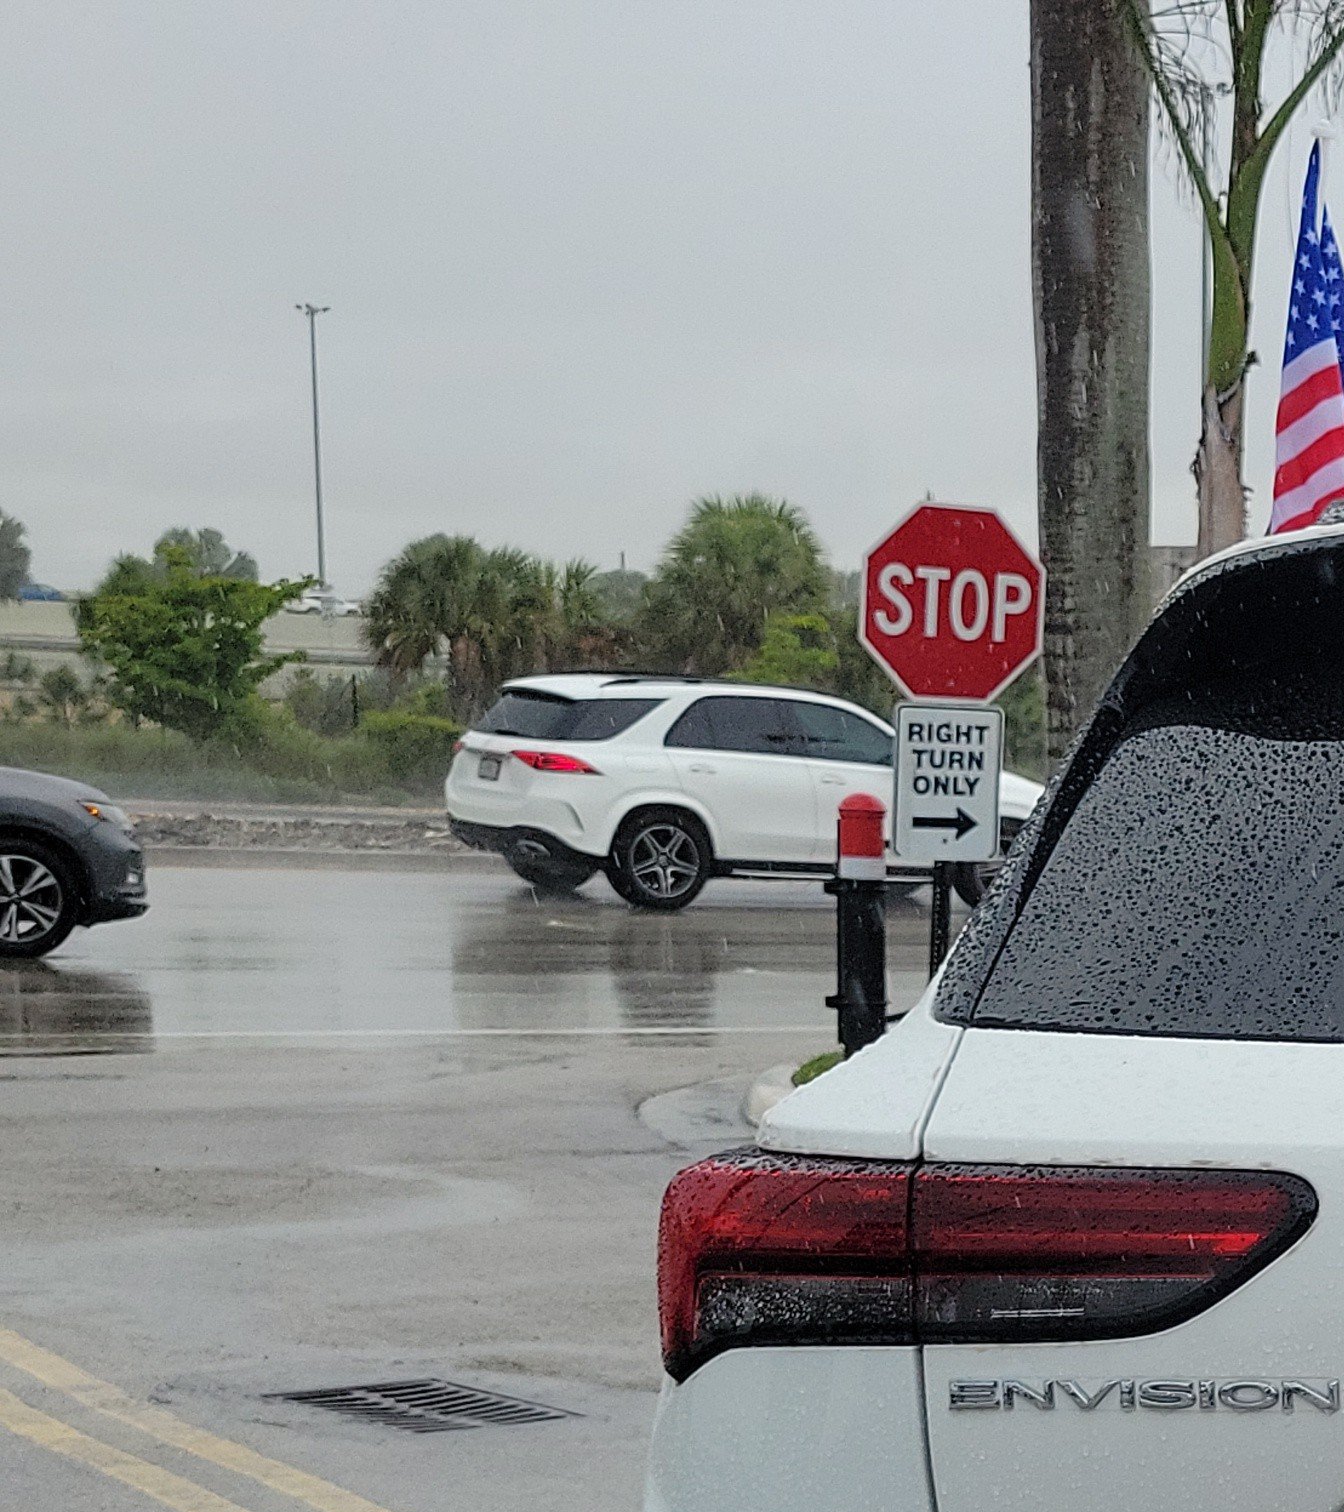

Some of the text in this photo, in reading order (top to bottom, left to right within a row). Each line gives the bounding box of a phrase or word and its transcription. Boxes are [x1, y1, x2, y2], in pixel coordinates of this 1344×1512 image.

[873, 562, 1033, 643] STOP
[908, 723, 990, 745] RIGHT
[911, 749, 985, 771] TURN
[913, 776, 981, 797] ONLY
[948, 1379, 1342, 1413] ENVISION
